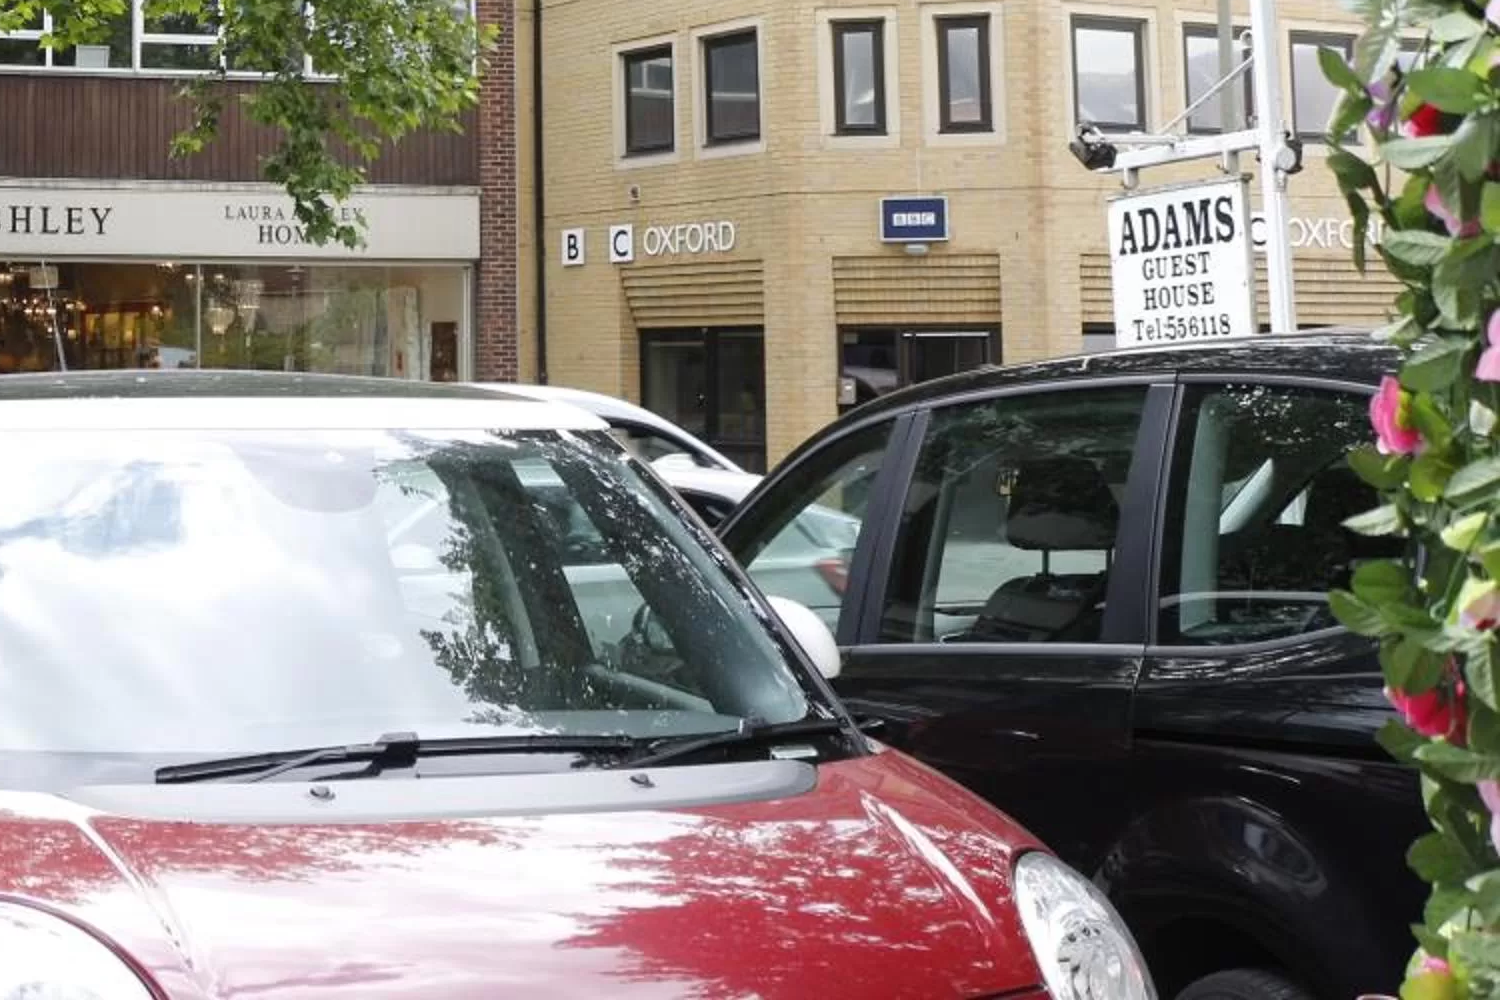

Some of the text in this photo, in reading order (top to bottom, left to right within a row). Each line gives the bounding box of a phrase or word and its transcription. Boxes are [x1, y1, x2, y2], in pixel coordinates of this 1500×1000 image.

[225, 206, 285, 221] LAURA
[1119, 195, 1235, 256] ADAMS
[566, 220, 736, 261] B C OXFORD
[1142, 251, 1211, 281] GUEST
[1143, 281, 1216, 312] HOUSE
